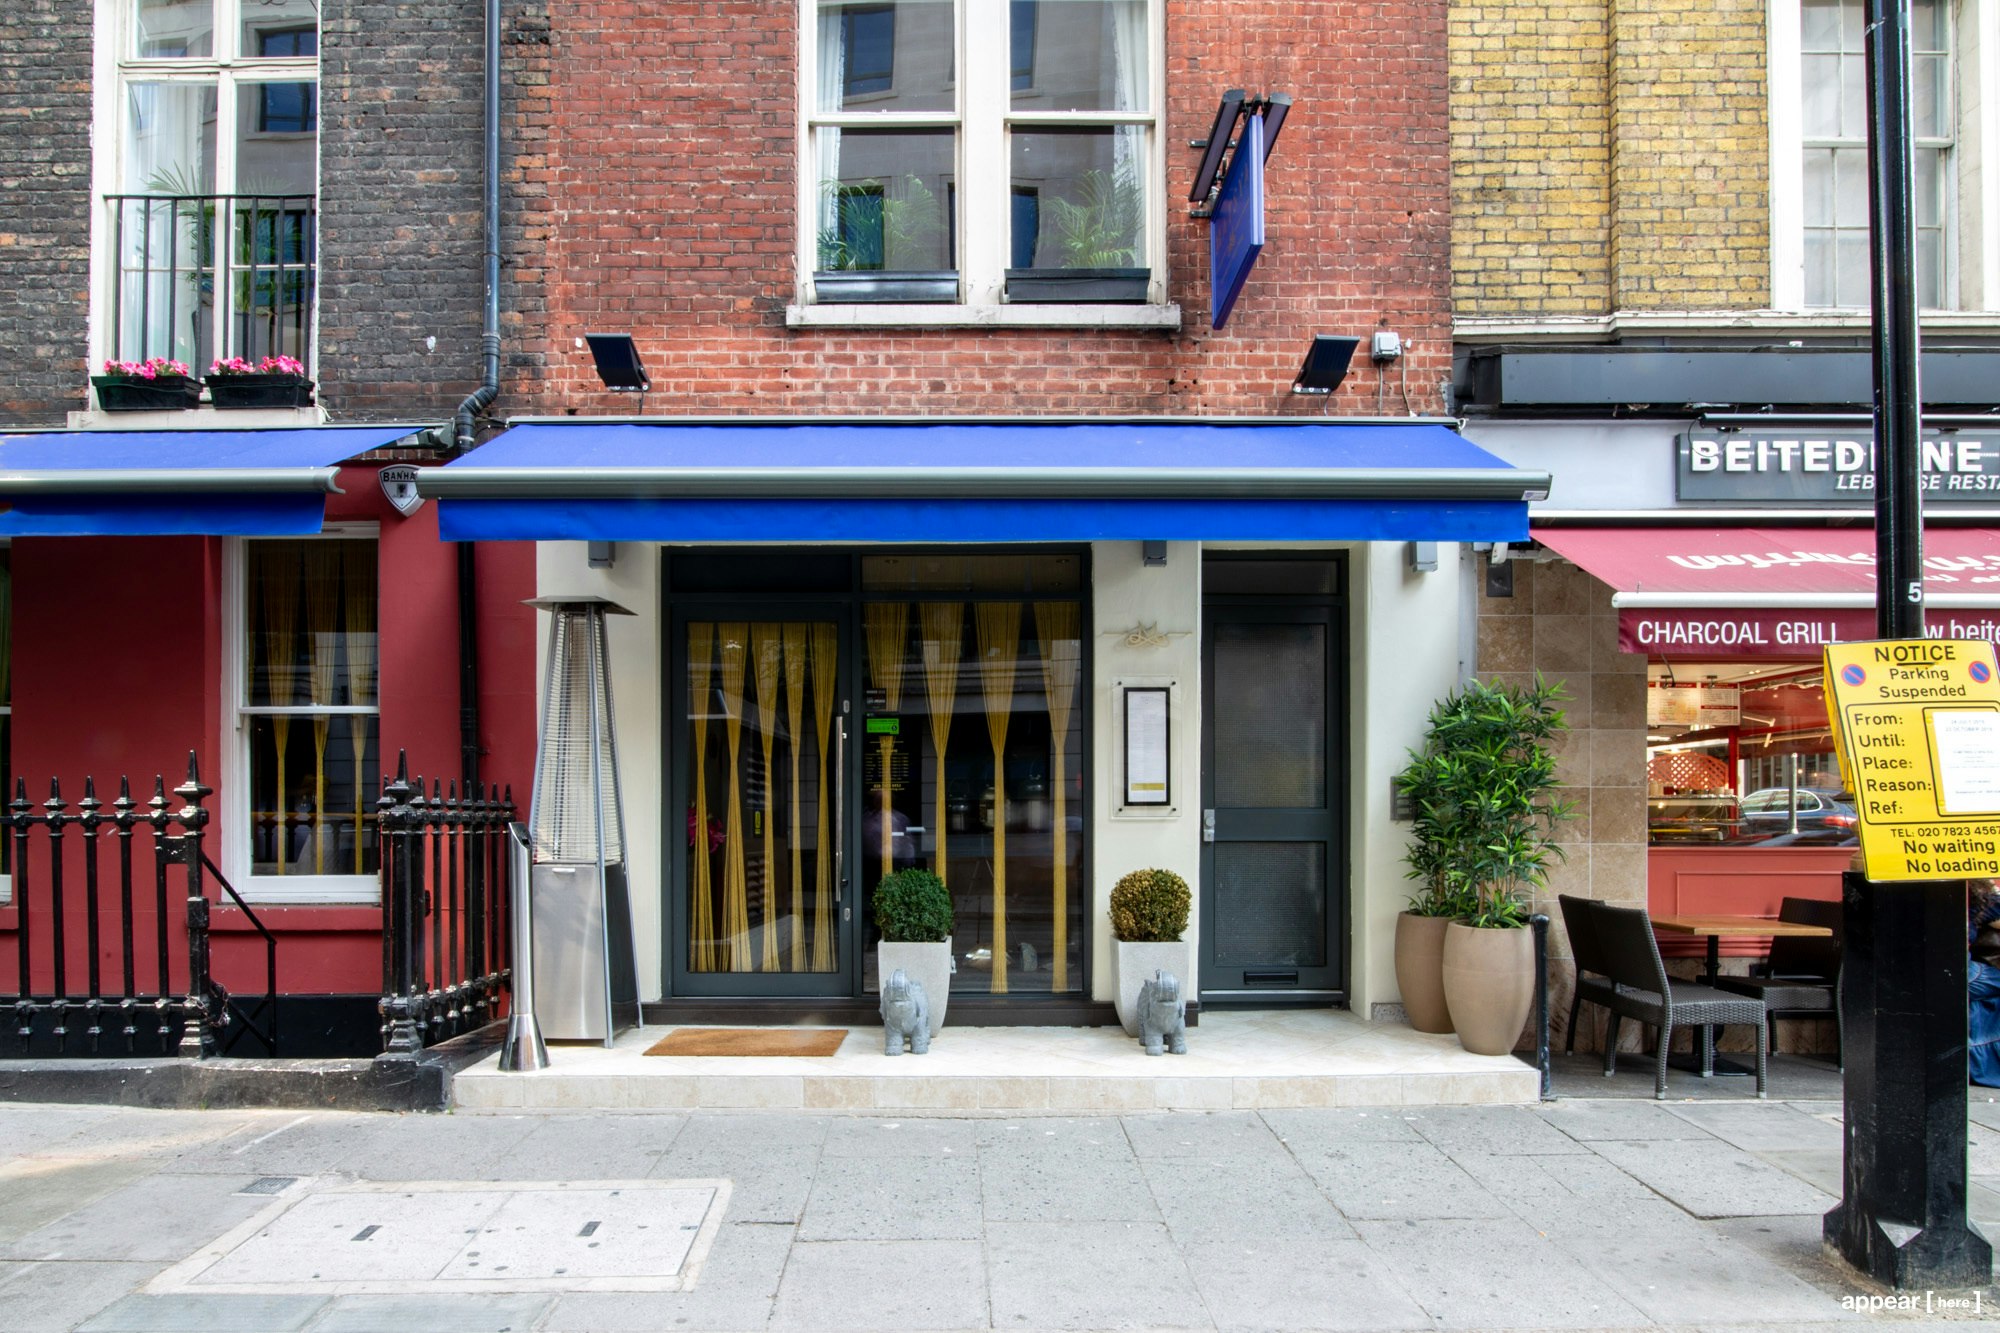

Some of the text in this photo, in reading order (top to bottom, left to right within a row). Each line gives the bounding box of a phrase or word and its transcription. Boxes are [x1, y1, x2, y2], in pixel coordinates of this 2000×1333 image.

[1691, 440, 1983, 472] BEITEDNE
[1836, 474, 1942, 490] LEBSE
[1907, 582, 1922, 602] 5
[1637, 620, 1843, 645] CHARCOAL GRILL
[1874, 645, 1956, 663] NOTICE
[1889, 667, 1950, 682] Parking
[1879, 684, 1966, 700] Suspended
[1854, 712, 1904, 727] From:
[1858, 734, 1905, 748] Until:
[1863, 756, 1913, 770] Place:
[1866, 778, 1932, 792] Reason:
[1870, 801, 1904, 815] Ref:
[1890, 828, 1914, 838] TEL:
[1917, 827, 1940, 837] 020
[1942, 826, 1971, 836] 7823
[1903, 839, 1996, 855] No waiting
[1906, 857, 1999, 874] No loading
